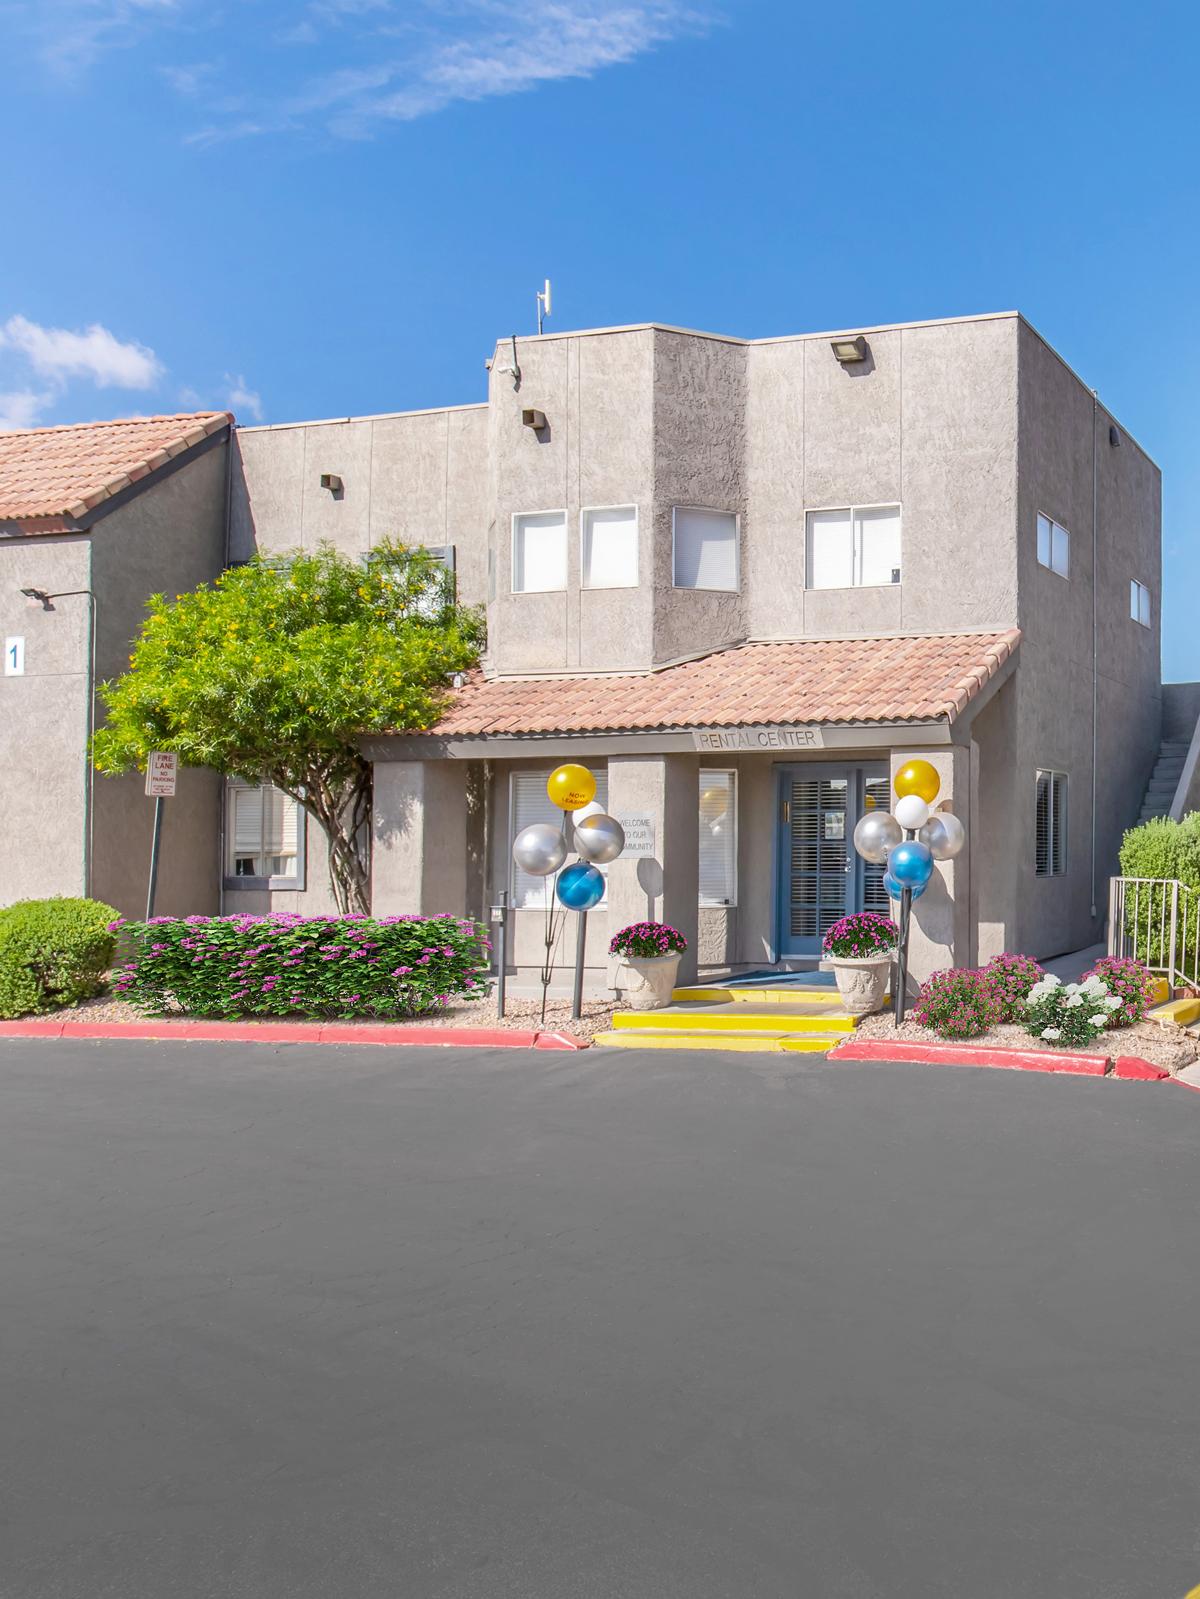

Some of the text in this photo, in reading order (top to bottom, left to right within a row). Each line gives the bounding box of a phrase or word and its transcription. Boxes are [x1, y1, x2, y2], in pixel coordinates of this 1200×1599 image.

[10, 644, 17, 668] 1
[700, 730, 816, 748] RENTAL CENTER
[157, 754, 173, 762] FIRE
[633, 830, 646, 839] OUR
